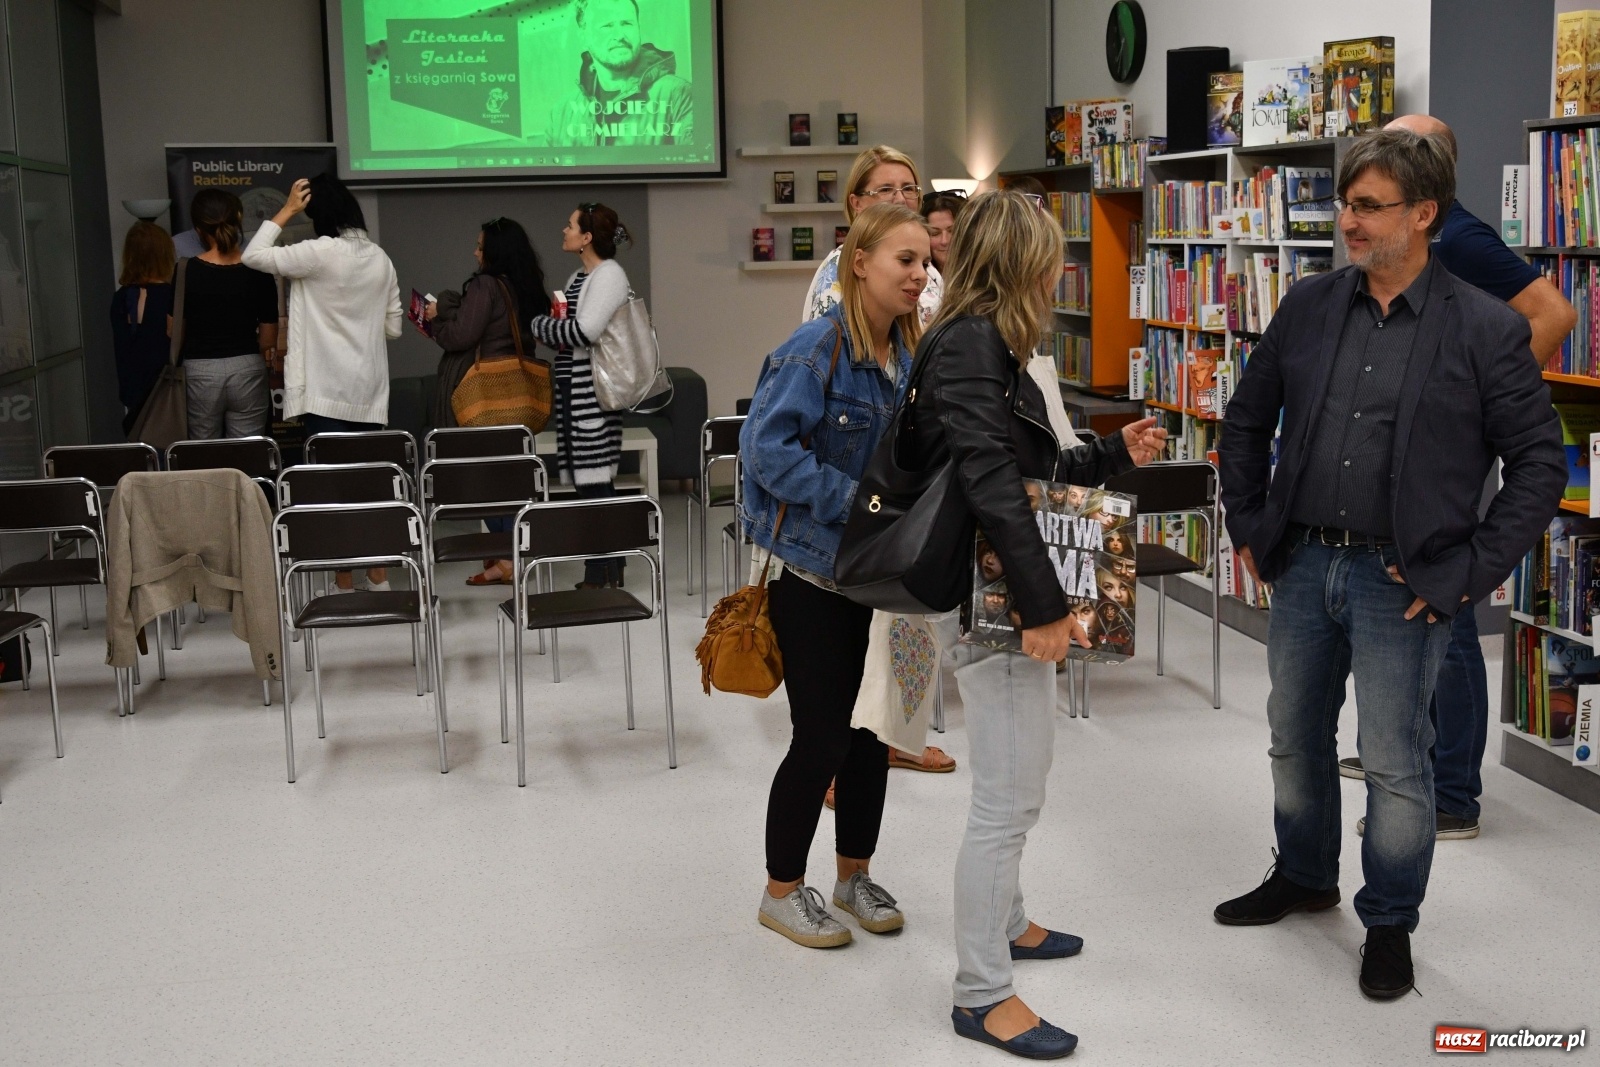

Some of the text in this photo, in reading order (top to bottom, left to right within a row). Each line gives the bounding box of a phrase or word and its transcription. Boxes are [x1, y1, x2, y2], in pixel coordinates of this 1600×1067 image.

[402, 29, 505, 44] Literacka
[421, 50, 488, 66] Jesień
[394, 72, 516, 86] z księgarnią Sowa
[570, 100, 673, 115] WOJCIECH
[566, 122, 683, 138] CHMIELARZ
[192, 160, 284, 175] Public Library
[1290, 171, 1330, 179] ATLAS
[193, 174, 252, 186] Raciborz
[1579, 698, 1592, 742] ZIEMIA
